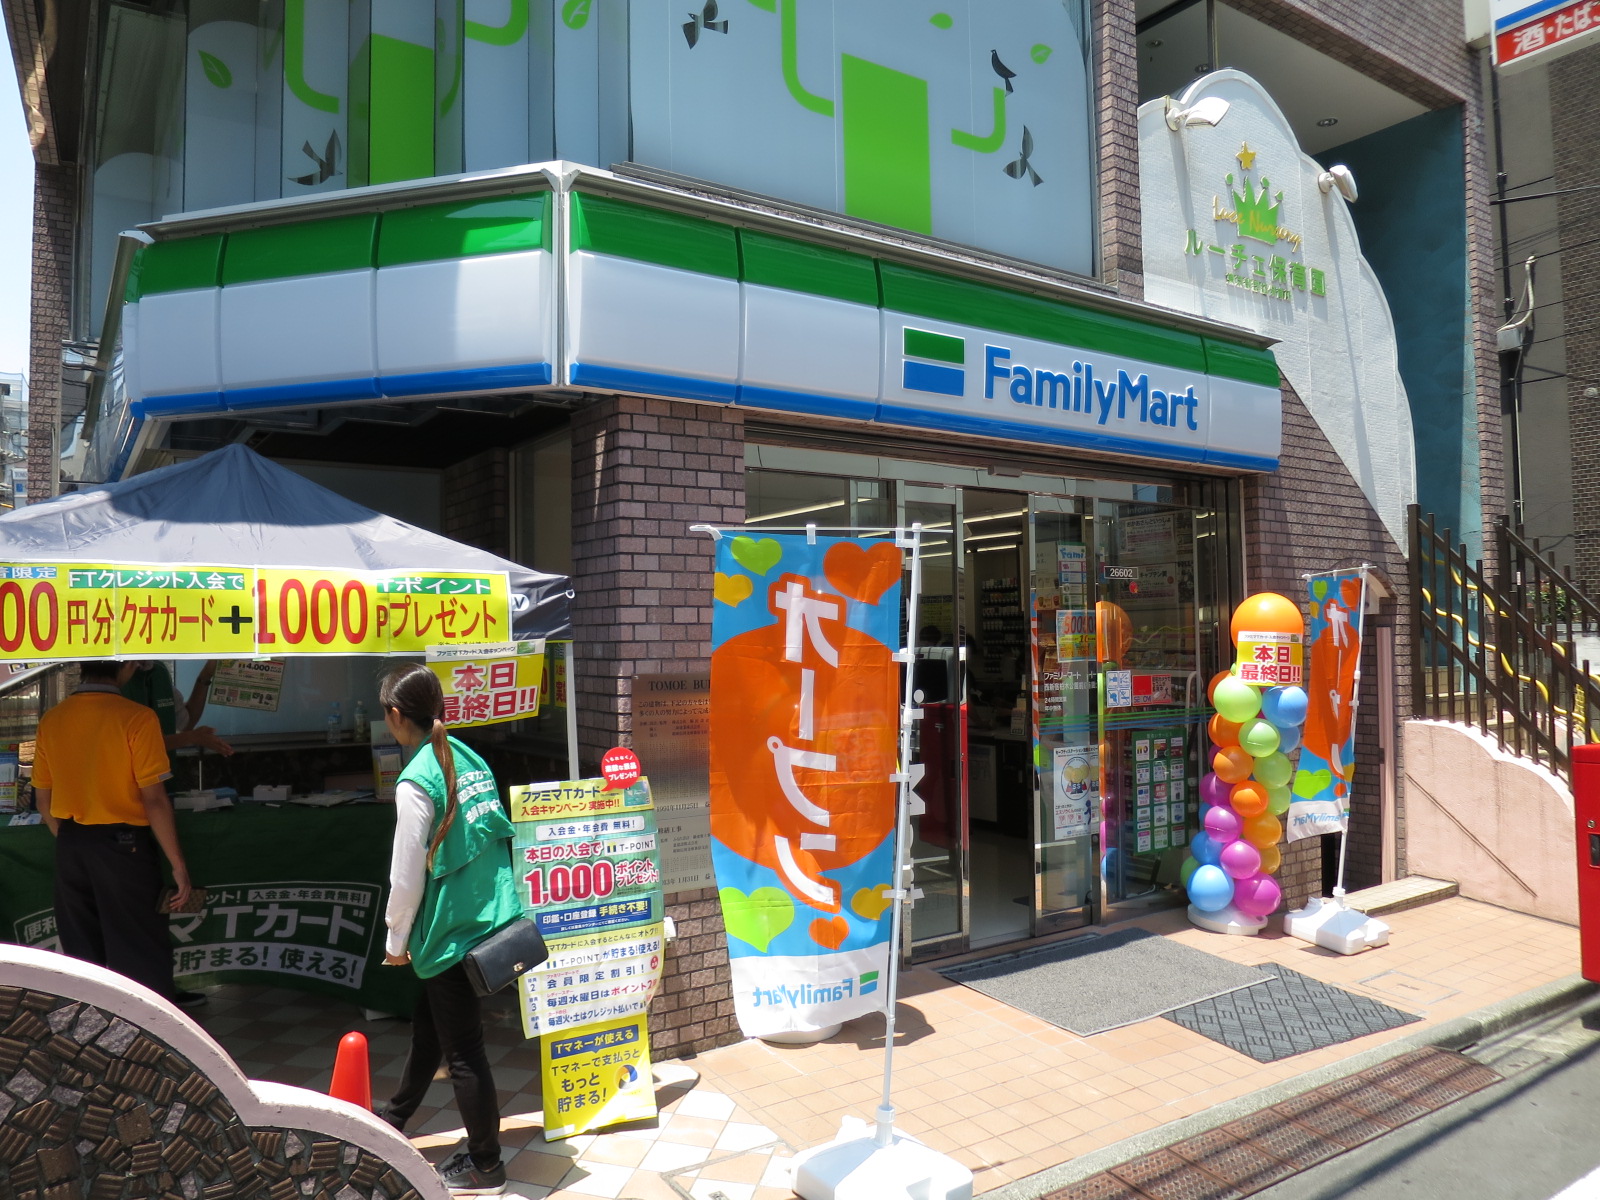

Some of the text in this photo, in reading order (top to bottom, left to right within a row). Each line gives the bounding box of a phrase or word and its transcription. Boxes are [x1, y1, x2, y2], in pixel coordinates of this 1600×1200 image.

[984, 344, 1198, 432] FamilyMart
[69, 570, 244, 590] FTクレジット入会で
[1110, 568, 1133, 577] 26602
[1255, 645, 1289, 663] 本日
[454, 662, 515, 692] 本日
[1241, 664, 1300, 682] 最終日!!
[649, 679, 687, 691] TOMOE
[443, 687, 536, 723] 最終日!!
[521, 786, 600, 803] ファミマTカード
[521, 801, 587, 816] 入会キャンペーン
[548, 822, 608, 836] 入会金・年会費
[526, 842, 601, 862] 本日の入会で
[619, 840, 654, 853] T-POINT
[616, 859, 653, 875] ポイント
[525, 861, 615, 905] 1,000
[617, 870, 659, 887] プレゼント!
[252, 889, 368, 904] 入会金・年会費無料!
[279, 948, 358, 984] 使える!
[559, 953, 600, 967] T-POINT
[530, 983, 536, 992] 2
[531, 1003, 537, 1012] 3
[533, 1022, 539, 1030] 4
[555, 1029, 634, 1055] Tマネーが使える
[551, 1049, 640, 1077] Tマネーで支払うと
[561, 1072, 601, 1093] もっと
[557, 1087, 607, 1114] 貯まる!
